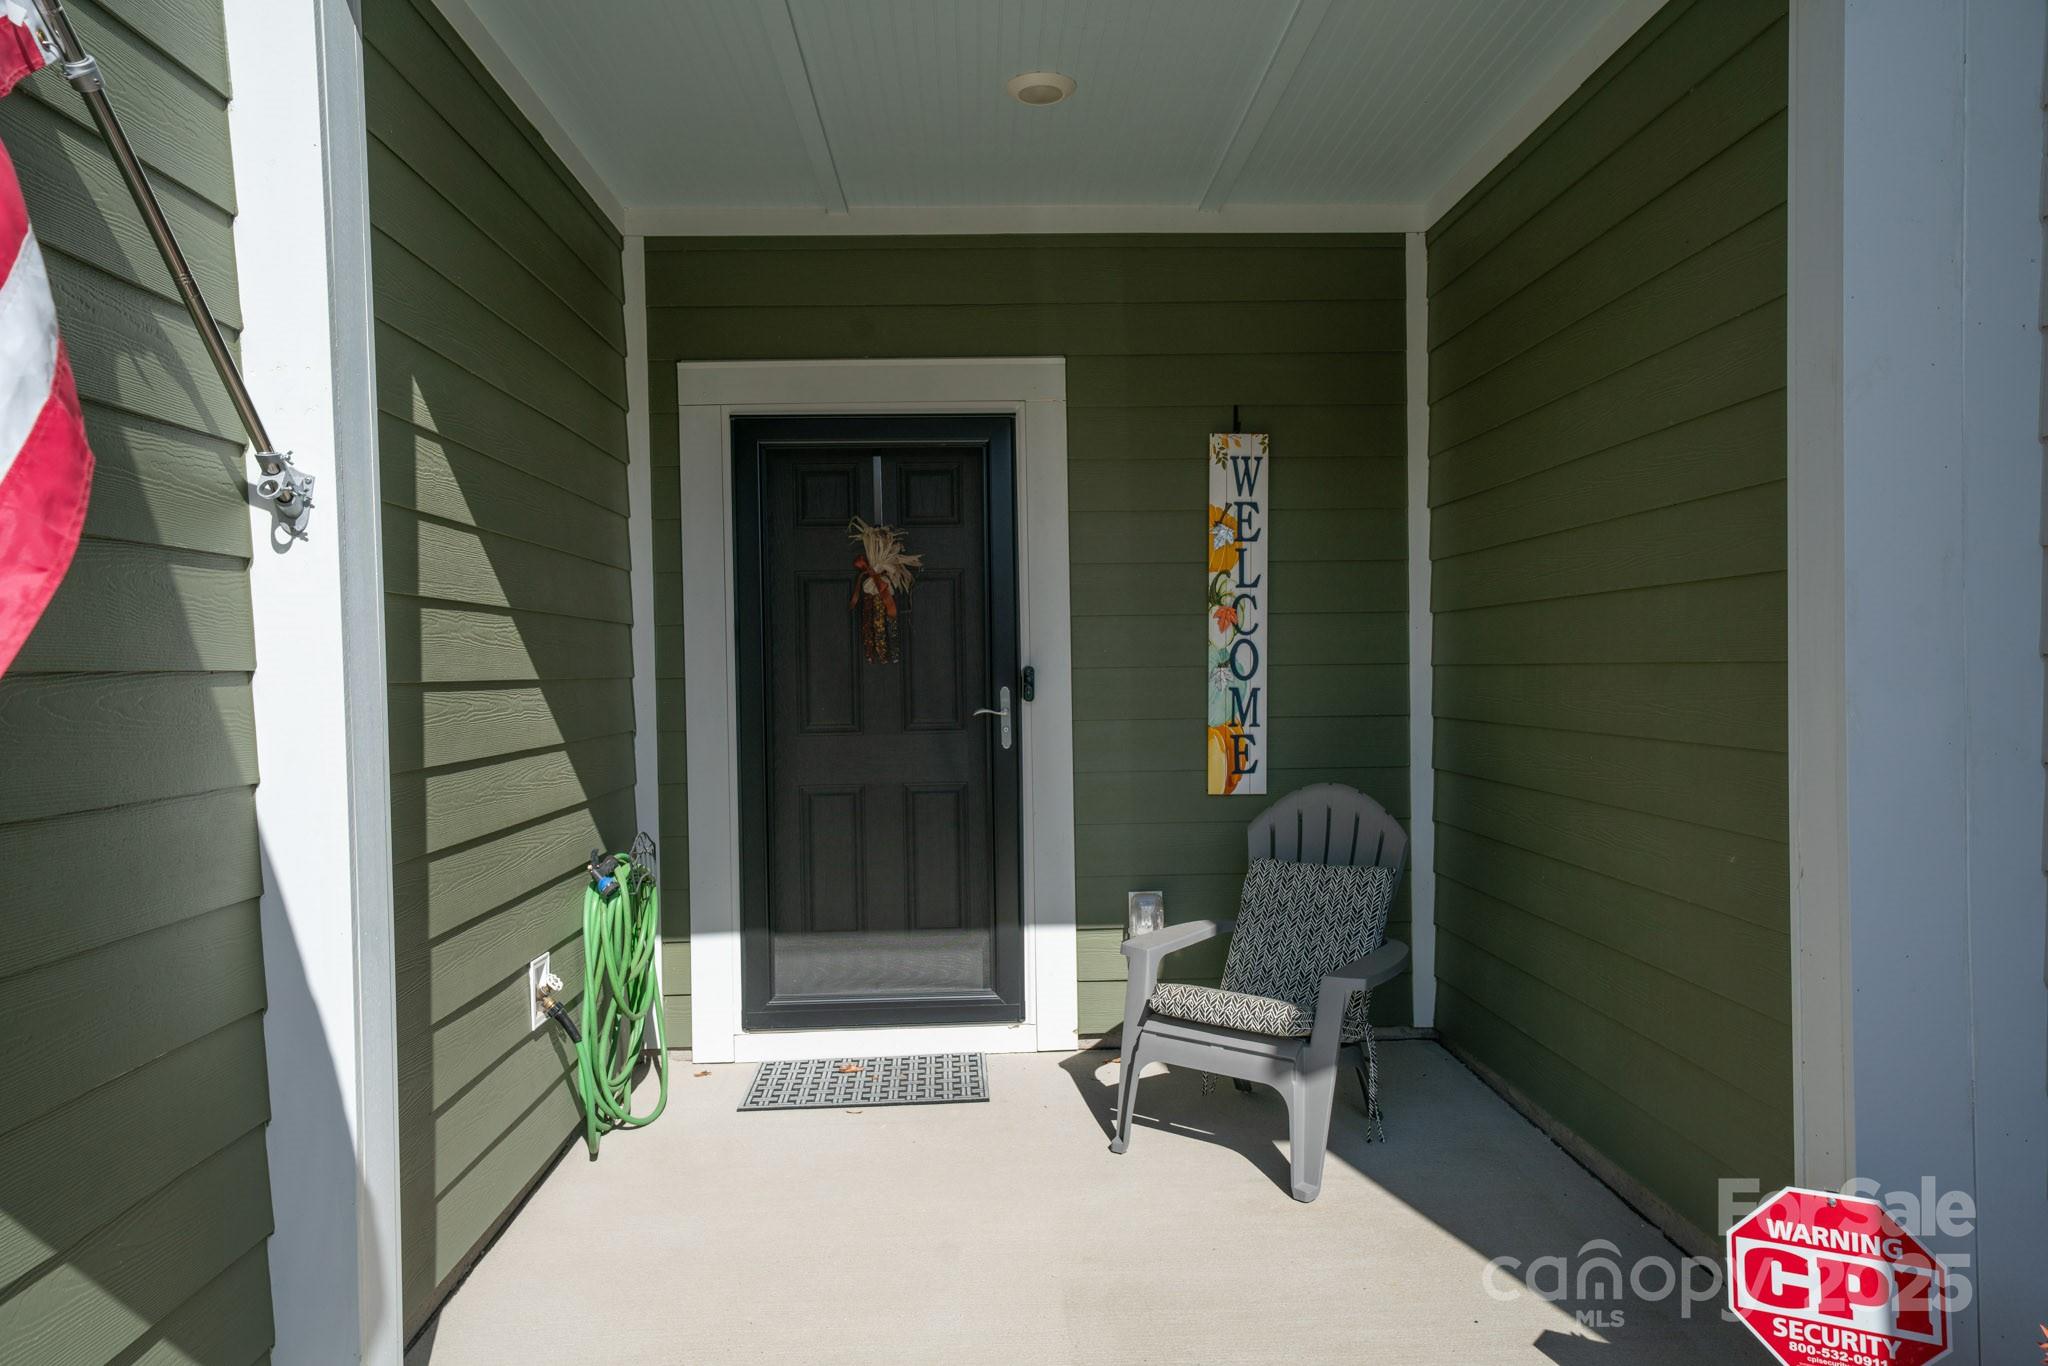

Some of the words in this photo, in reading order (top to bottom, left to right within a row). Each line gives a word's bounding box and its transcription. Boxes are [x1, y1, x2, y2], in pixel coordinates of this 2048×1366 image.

[1229, 456, 1262, 775] WELCOME
[1766, 1218, 1904, 1260] WARNING
[1744, 1247, 1934, 1336] CPI
[1773, 1317, 1903, 1360] SECURITY
[1789, 1341, 1889, 1366] 800-532-0911
